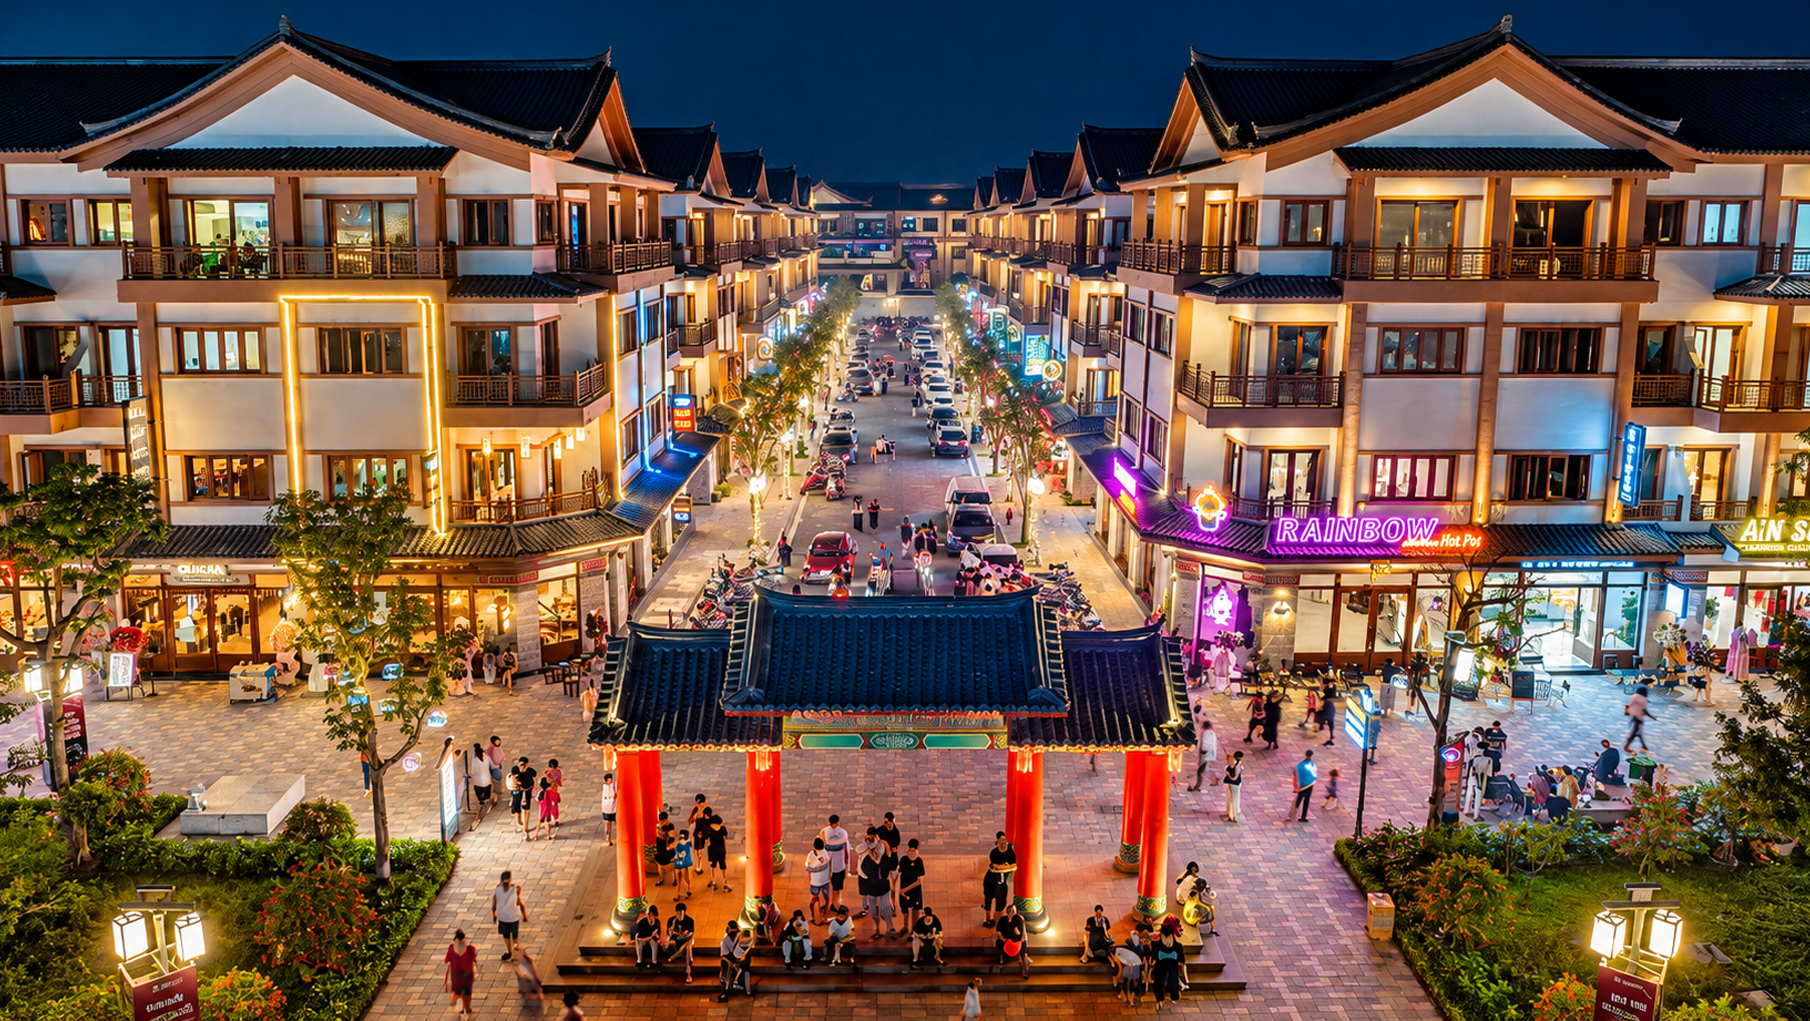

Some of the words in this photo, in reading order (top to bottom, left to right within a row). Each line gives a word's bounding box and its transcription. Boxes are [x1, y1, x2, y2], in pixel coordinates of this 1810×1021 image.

[1276, 517, 1439, 543] RAINBOW
[1440, 533, 1462, 548] Hot
[1790, 519, 1810, 542] S
